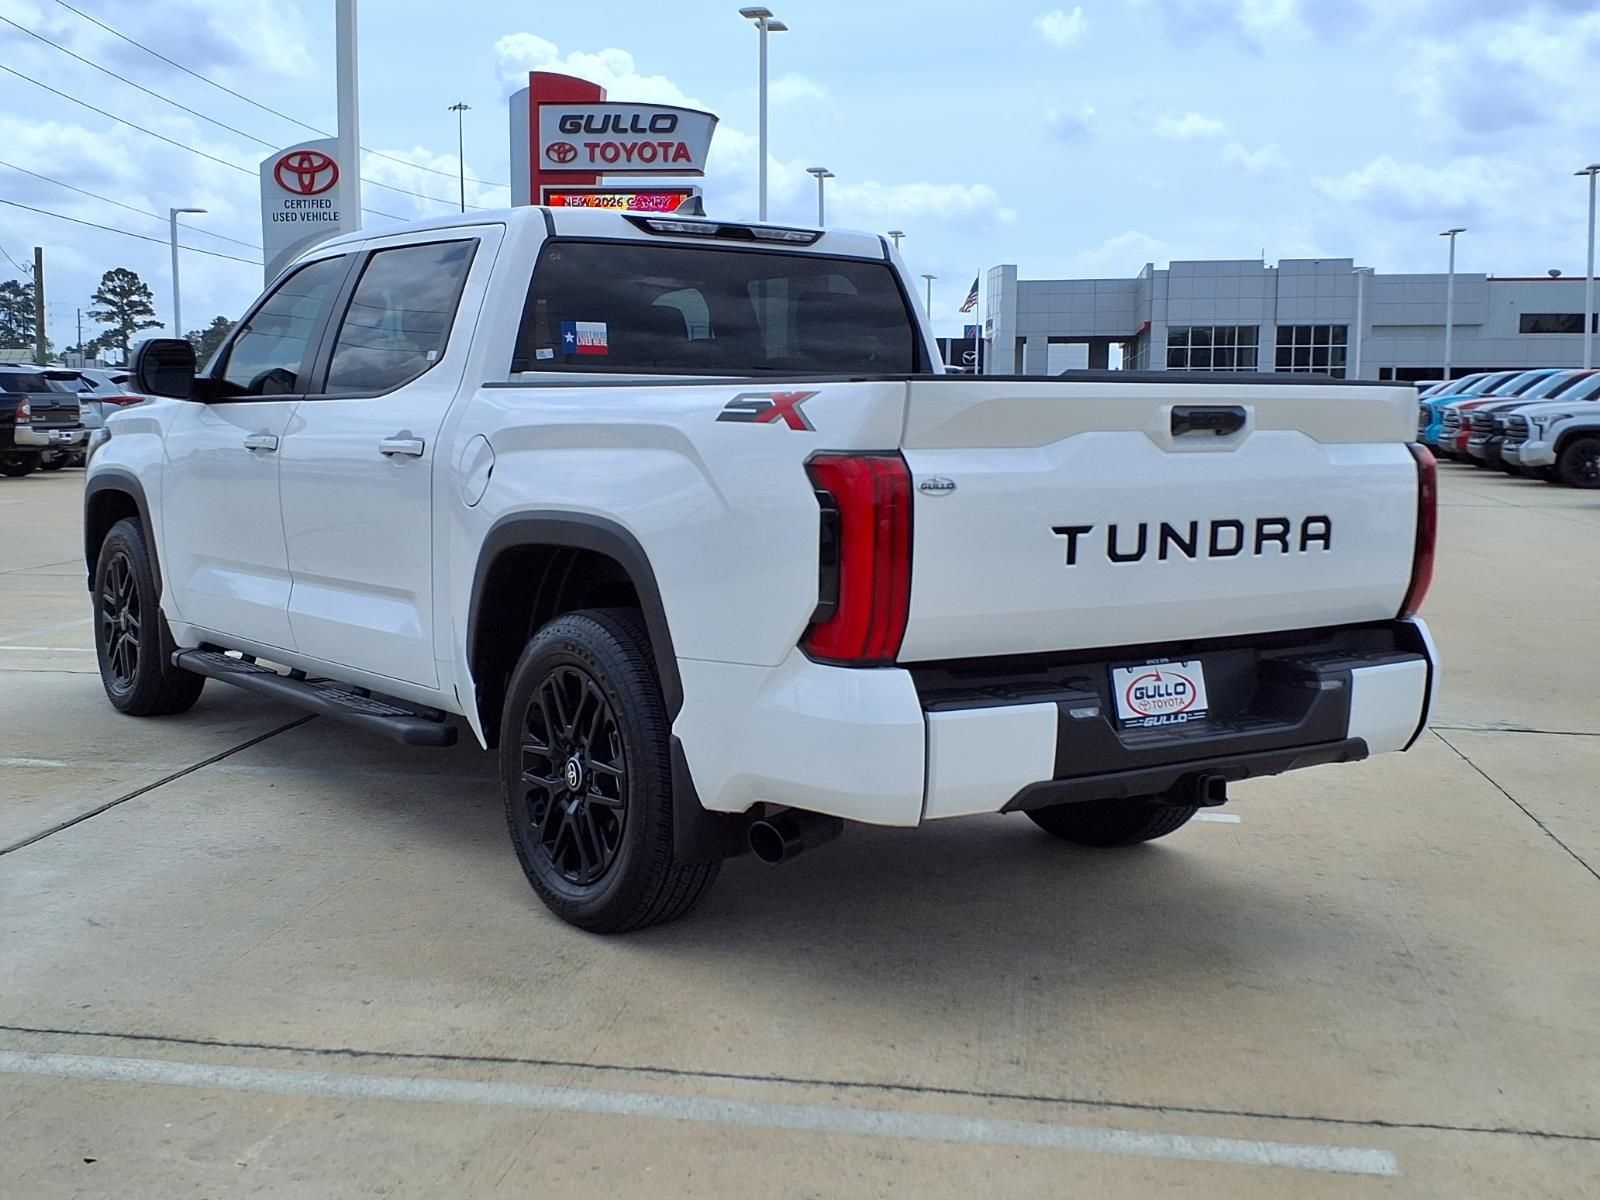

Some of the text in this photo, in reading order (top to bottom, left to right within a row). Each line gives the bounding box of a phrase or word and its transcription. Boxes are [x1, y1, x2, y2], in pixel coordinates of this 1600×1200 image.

[559, 114, 678, 134] GULLO
[583, 142, 692, 163] TOYOTA
[284, 199, 332, 209] CERTIFIED
[565, 196, 672, 209] NEW 2026 CAMRY
[272, 211, 340, 222] USED VEHICLE
[920, 482, 956, 490] GULLO
[1051, 515, 1331, 565] TUNDRA
[1134, 682, 1186, 700] GULLO
[1152, 697, 1185, 709] TOYOTA
[1143, 713, 1187, 727] GULLO
